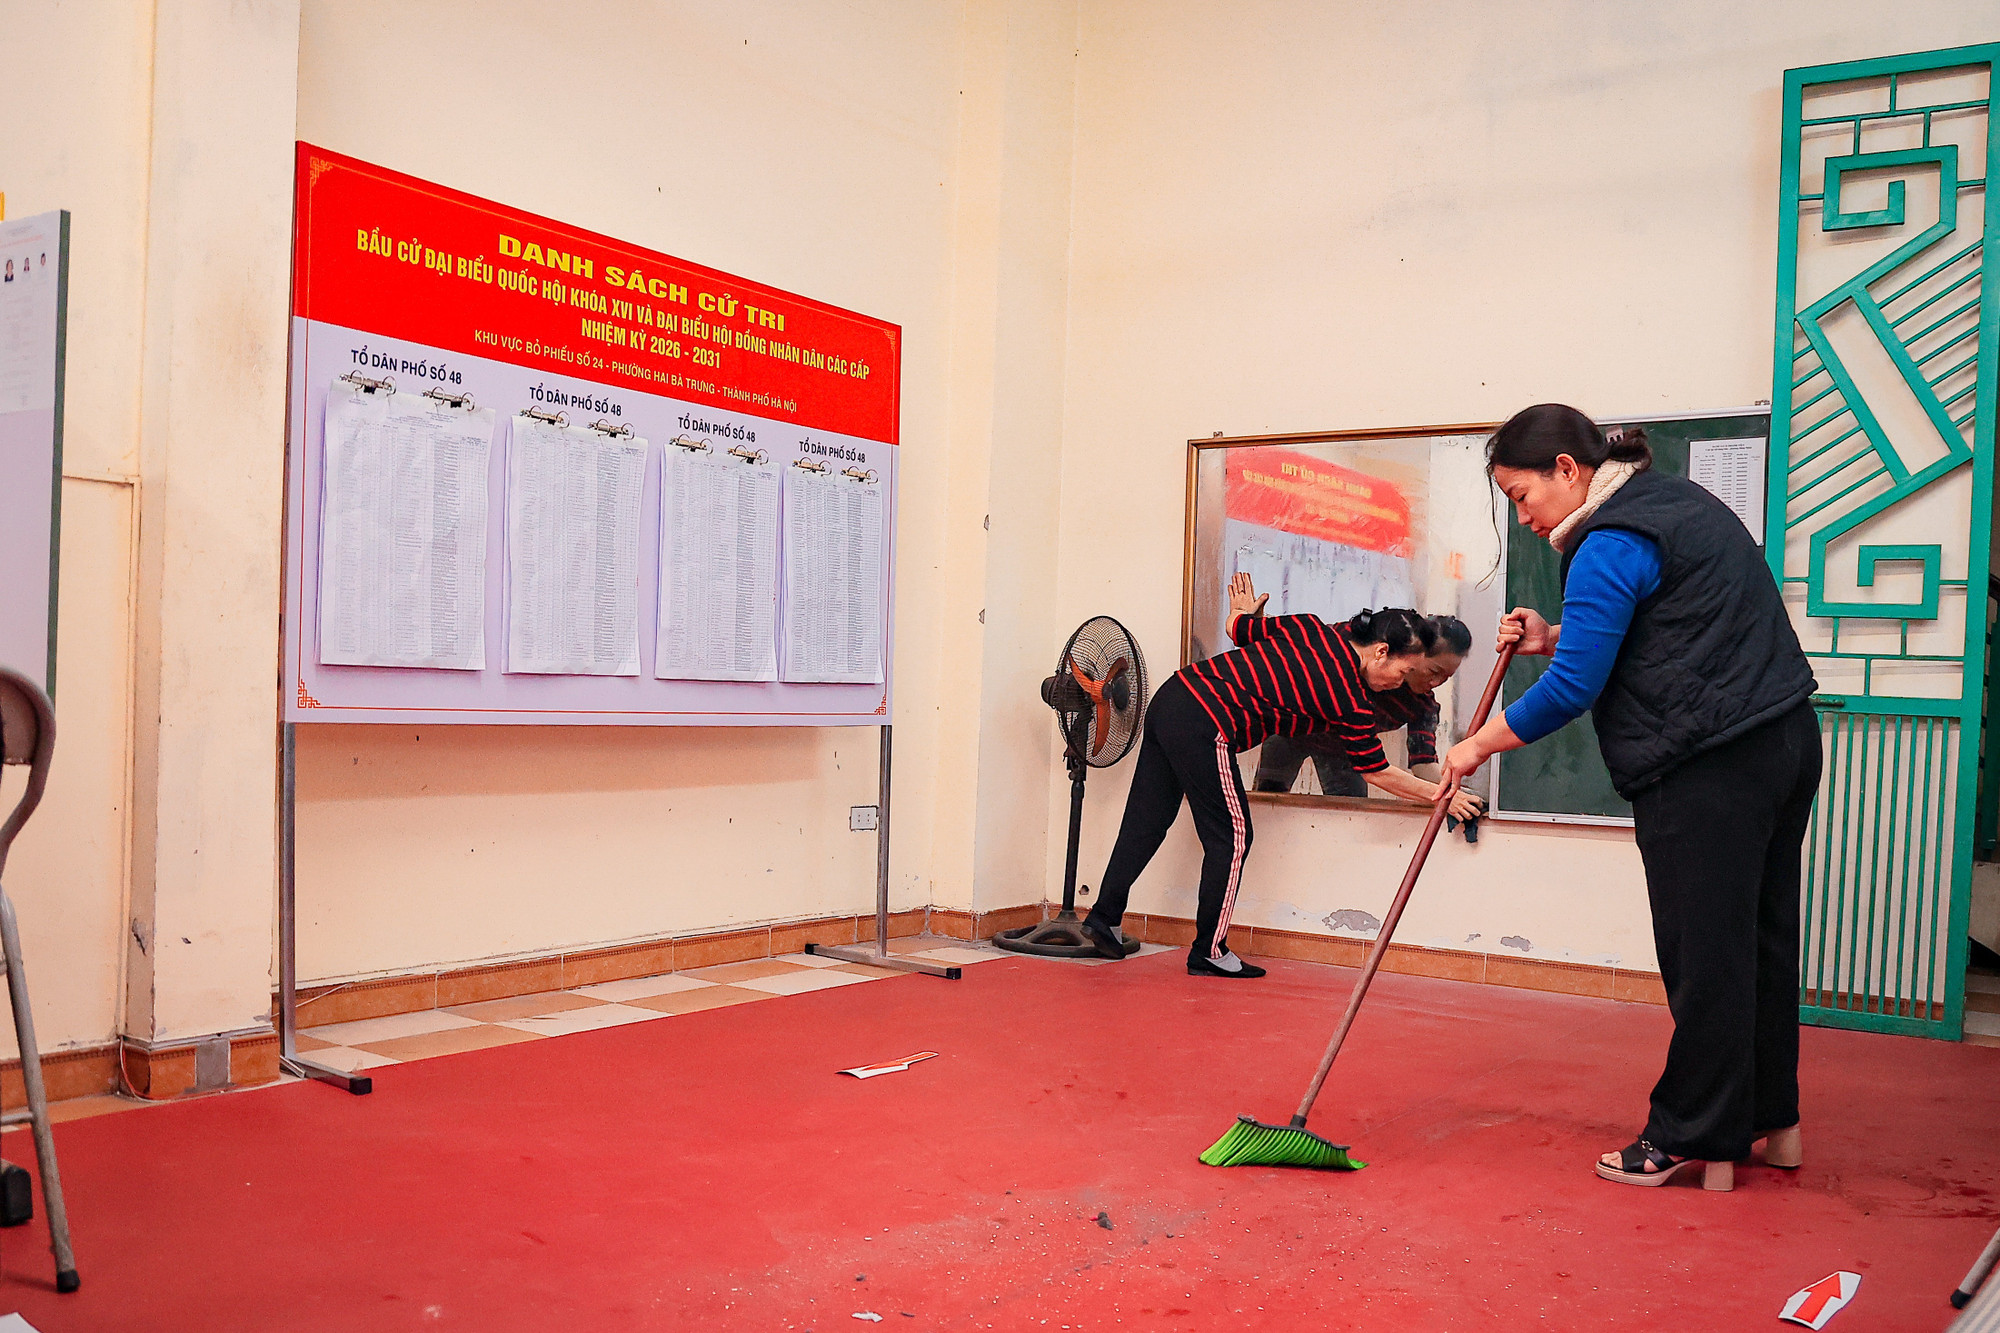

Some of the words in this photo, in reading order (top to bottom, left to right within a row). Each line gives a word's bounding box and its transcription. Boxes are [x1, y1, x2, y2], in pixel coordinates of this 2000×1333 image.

[358, 227, 392, 257] BẦU
[398, 238, 422, 264] CỬ
[425, 248, 452, 276] ĐẠI
[458, 255, 493, 283] BIỂU
[498, 269, 537, 295] QUỐC
[542, 279, 566, 306] HỘI
[571, 288, 607, 314] KHÓA
[611, 299, 632, 320] XVI
[637, 304, 653, 326] VÀ
[657, 311, 677, 334] ĐẠI
[682, 315, 709, 340] BIỂU
[713, 325, 732, 348] HỘI
[735, 329, 766, 354] ĐỒNG
[770, 341, 799, 363] NHÂN
[803, 349, 824, 369] DÂN
[828, 355, 847, 375] CÁC
[850, 359, 869, 380] CẤP
[499, 234, 593, 279] DANH
[605, 266, 687, 305] SÁCH
[699, 293, 738, 317] CỬ
[744, 305, 784, 331] TRI
[350, 344, 369, 366] TỔ
[371, 352, 398, 372] DÂN
[401, 359, 427, 378] PHỐ
[429, 363, 447, 382] SỐ
[448, 370, 462, 385] 48
[582, 318, 625, 346] NHIỆM
[630, 329, 646, 350] KỲ
[650, 336, 680, 358] 2026
[693, 348, 720, 368] 2031
[474, 329, 498, 346] KHU
[500, 335, 523, 352] VỰC
[525, 338, 542, 356] BỎ
[543, 344, 574, 363] PHIẾU
[576, 350, 591, 367] SỐ
[592, 356, 604, 370] 24
[611, 360, 652, 380] PHƯỜNG
[653, 370, 669, 385] HAI
[670, 372, 684, 388] BÀ
[685, 377, 715, 395] TRƯNG
[722, 385, 751, 402] THÀNH
[752, 391, 770, 407] PHỐ
[770, 395, 783, 409] HÀ
[783, 398, 797, 414] NỘI
[529, 382, 544, 402] TỔ
[546, 388, 569, 406] DÂN
[570, 393, 593, 411] PHỐ
[594, 397, 609, 414] SỐ
[610, 403, 622, 417] 48
[677, 412, 691, 430] TỔ
[692, 418, 711, 434] DÂN
[712, 422, 731, 438] PHỐ
[732, 425, 745, 441] SỐ
[745, 430, 756, 443] 48
[798, 436, 810, 453] TỔ
[811, 441, 828, 457] DÂN
[828, 444, 845, 460] PHỐ
[845, 447, 857, 462] SỐ
[857, 452, 866, 464] 48
